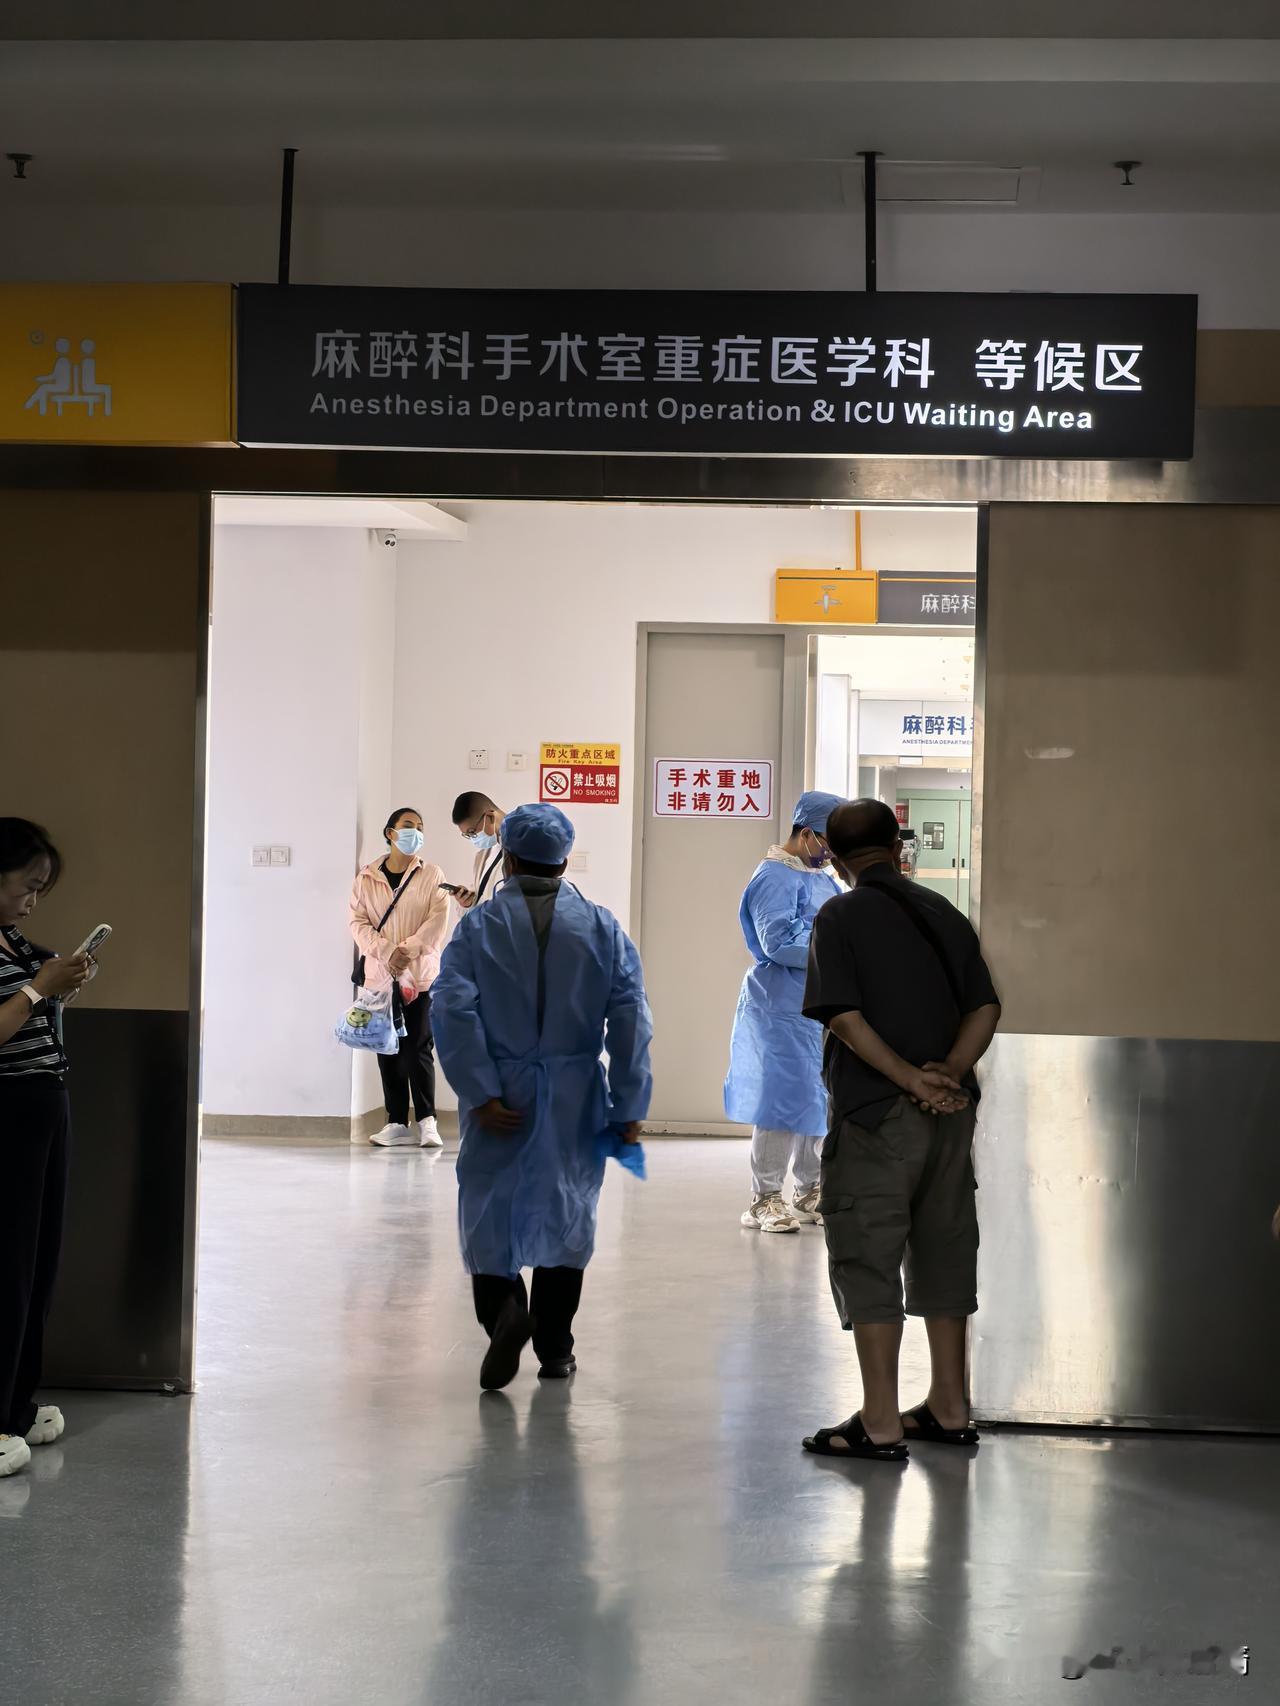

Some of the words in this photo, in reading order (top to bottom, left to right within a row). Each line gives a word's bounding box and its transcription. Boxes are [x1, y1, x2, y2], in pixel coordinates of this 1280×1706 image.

[311, 329, 935, 389] 麻醉科手术室重症医学科
[974, 339, 1145, 392] 等候区
[309, 393, 471, 416] Anesthesia
[480, 395, 648, 422] Department
[657, 397, 801, 424] Operation
[810, 400, 836, 423] &
[844, 401, 895, 424] ICU
[903, 403, 1015, 434] Waiting
[1022, 406, 1093, 430] Area
[902, 715, 974, 735] 麻醉科
[545, 748, 615, 760] 防火重点区域
[573, 772, 616, 787] 禁止吸烟
[667, 768, 761, 789] 手术重地
[667, 791, 760, 812] 非请勿入
